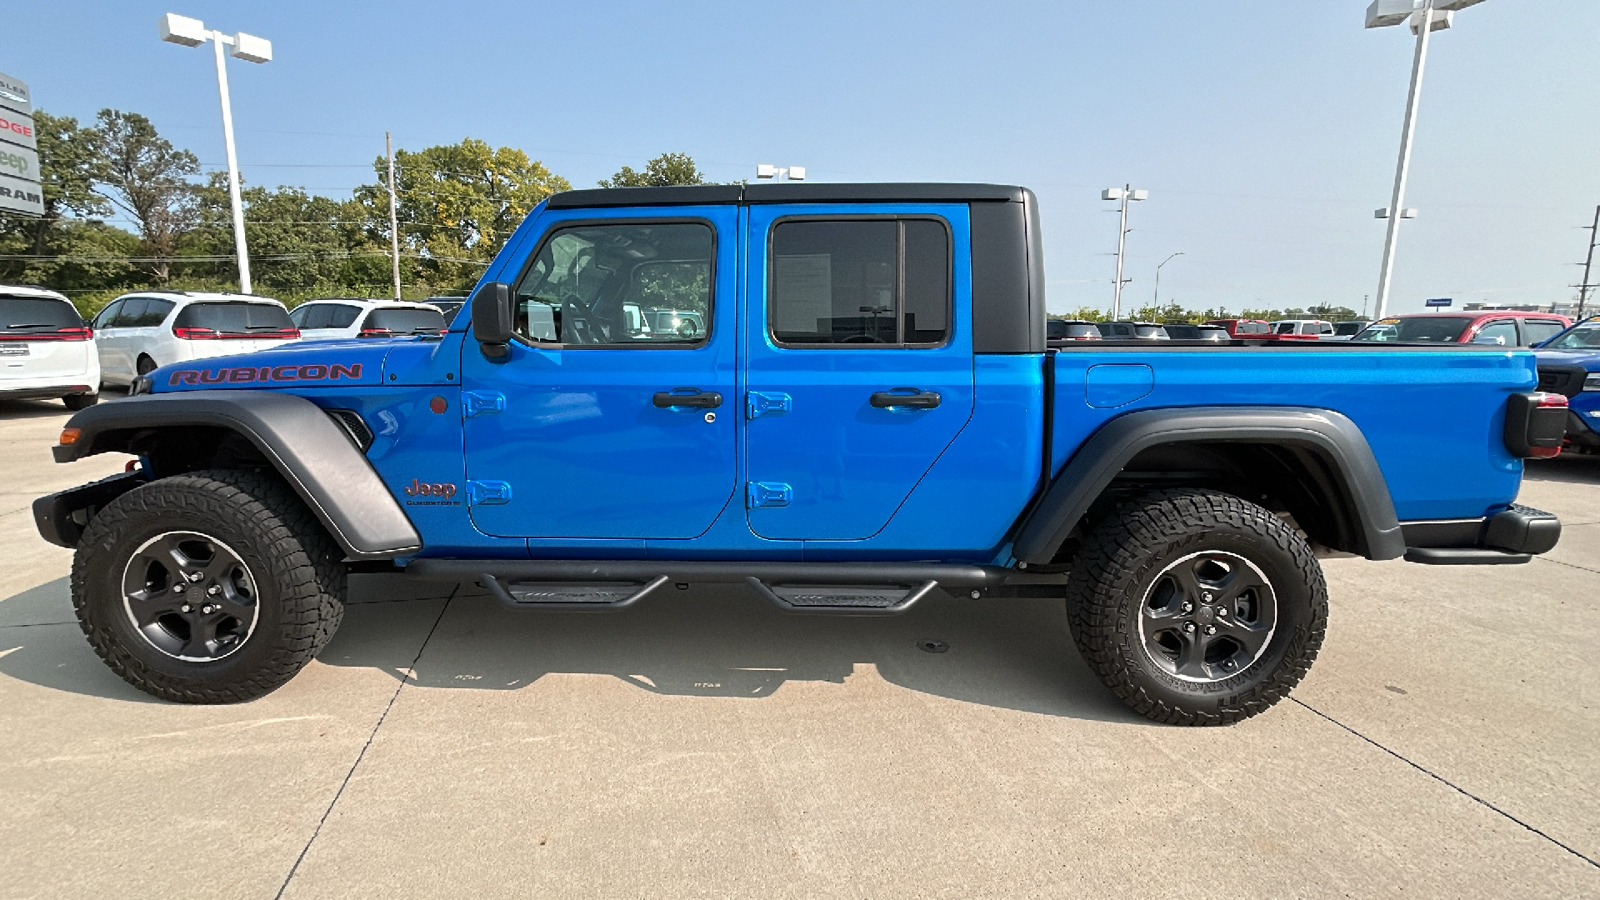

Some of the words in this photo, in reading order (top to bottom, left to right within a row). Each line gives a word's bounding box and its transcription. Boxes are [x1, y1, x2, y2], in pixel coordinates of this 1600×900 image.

[0, 186, 41, 204] RAM
[169, 363, 362, 386] RUBICON
[404, 477, 457, 500] Jeep
